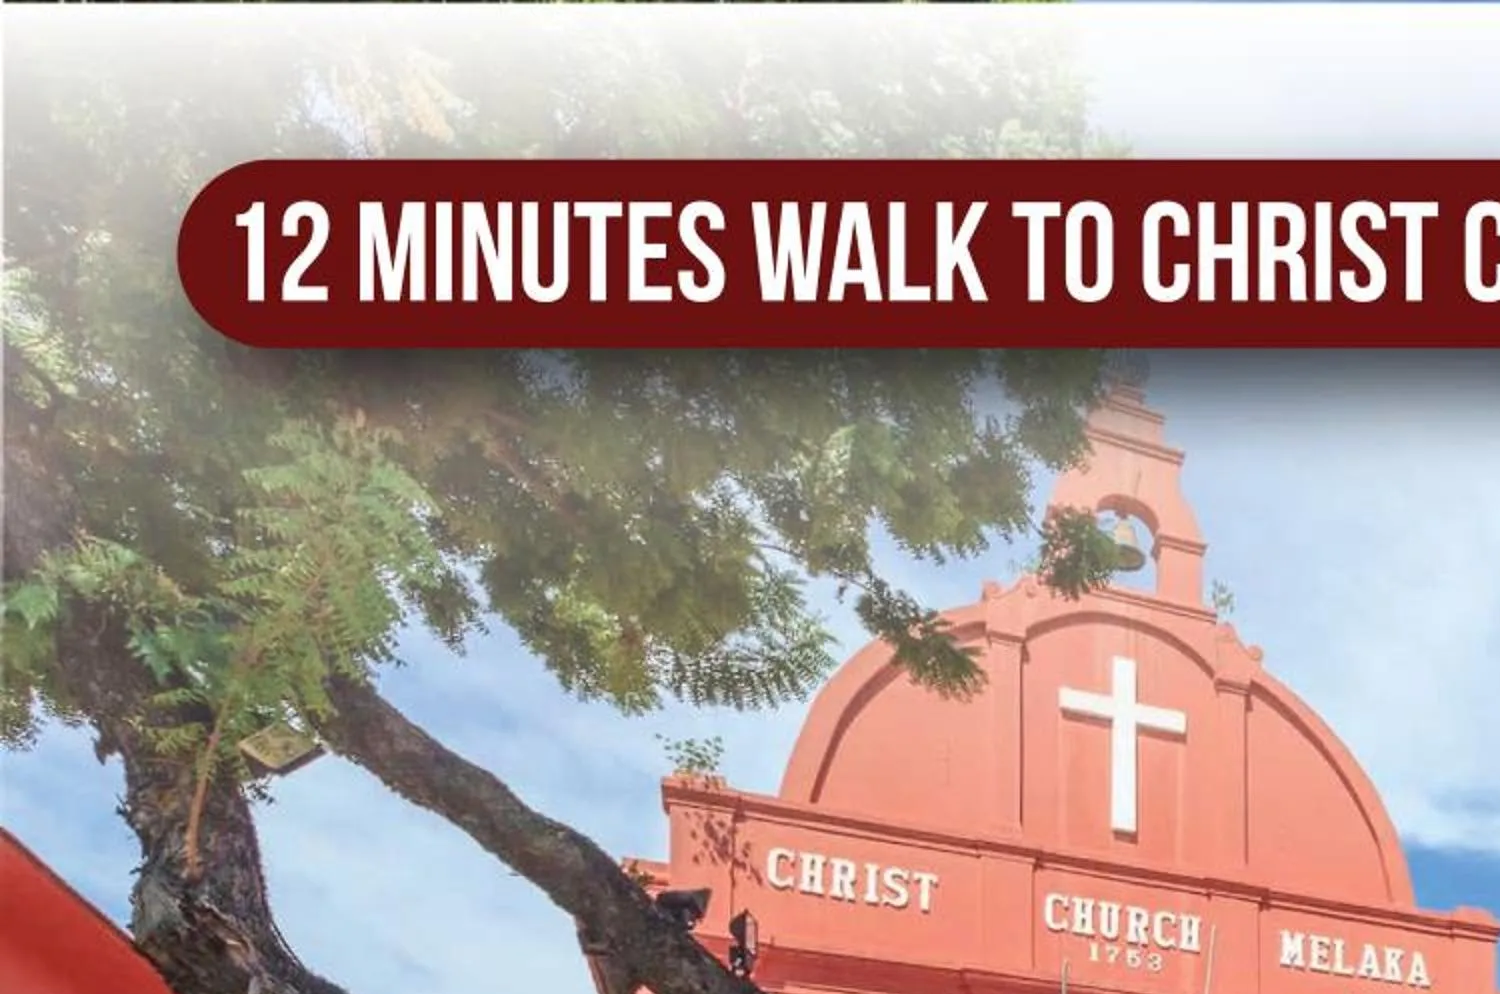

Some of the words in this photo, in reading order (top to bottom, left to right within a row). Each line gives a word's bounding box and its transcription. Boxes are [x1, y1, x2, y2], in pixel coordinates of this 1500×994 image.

[766, 848, 939, 913] CHRIST
[1043, 893, 1202, 954] CHURCH
[1279, 930, 1431, 988] MELAKA
[1089, 942, 1163, 972] 1753
